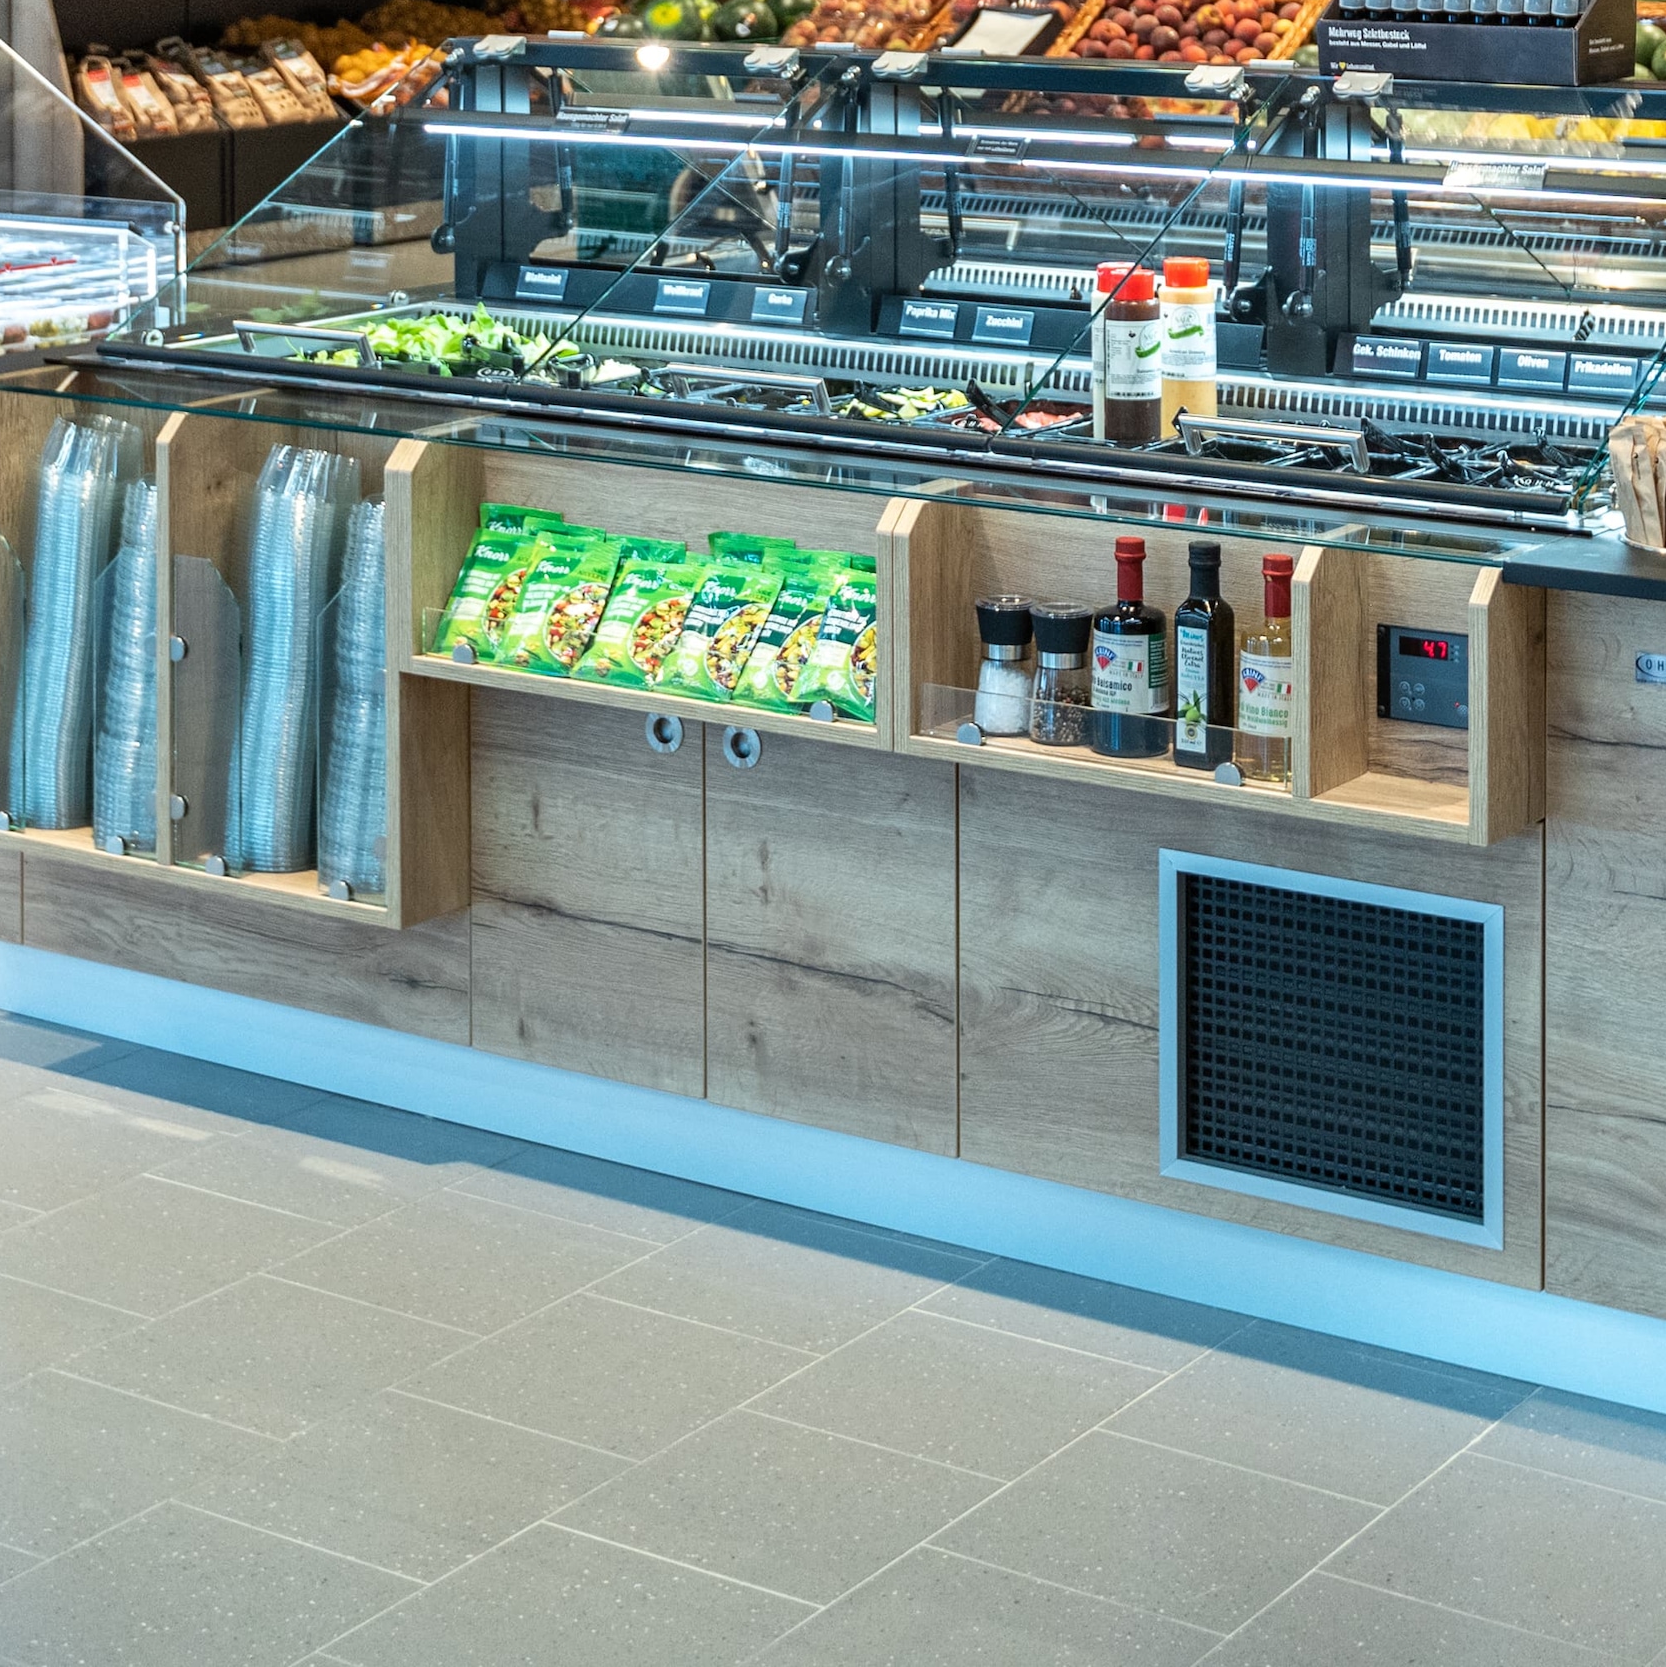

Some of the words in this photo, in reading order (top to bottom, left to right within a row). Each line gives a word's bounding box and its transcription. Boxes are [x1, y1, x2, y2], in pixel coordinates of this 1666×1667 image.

[1328, 26, 1362, 40] Mehrweg
[905, 304, 939, 319] Paprika
[939, 308, 957, 320] Mix
[985, 315, 1024, 329] Zucchini
[1353, 343, 1375, 356] Gek.
[1376, 345, 1422, 360] Schinken
[1439, 349, 1483, 363] Tomaten
[1517, 354, 1550, 369] Oliven
[1574, 360, 1633, 376] Frikadellen
[474, 544, 511, 563] Knorr
[536, 559, 572, 576] Knorr
[1096, 677, 1133, 692] Balsamico
[1246, 702, 1260, 715] Vino
[1261, 706, 1289, 719] Bianco
